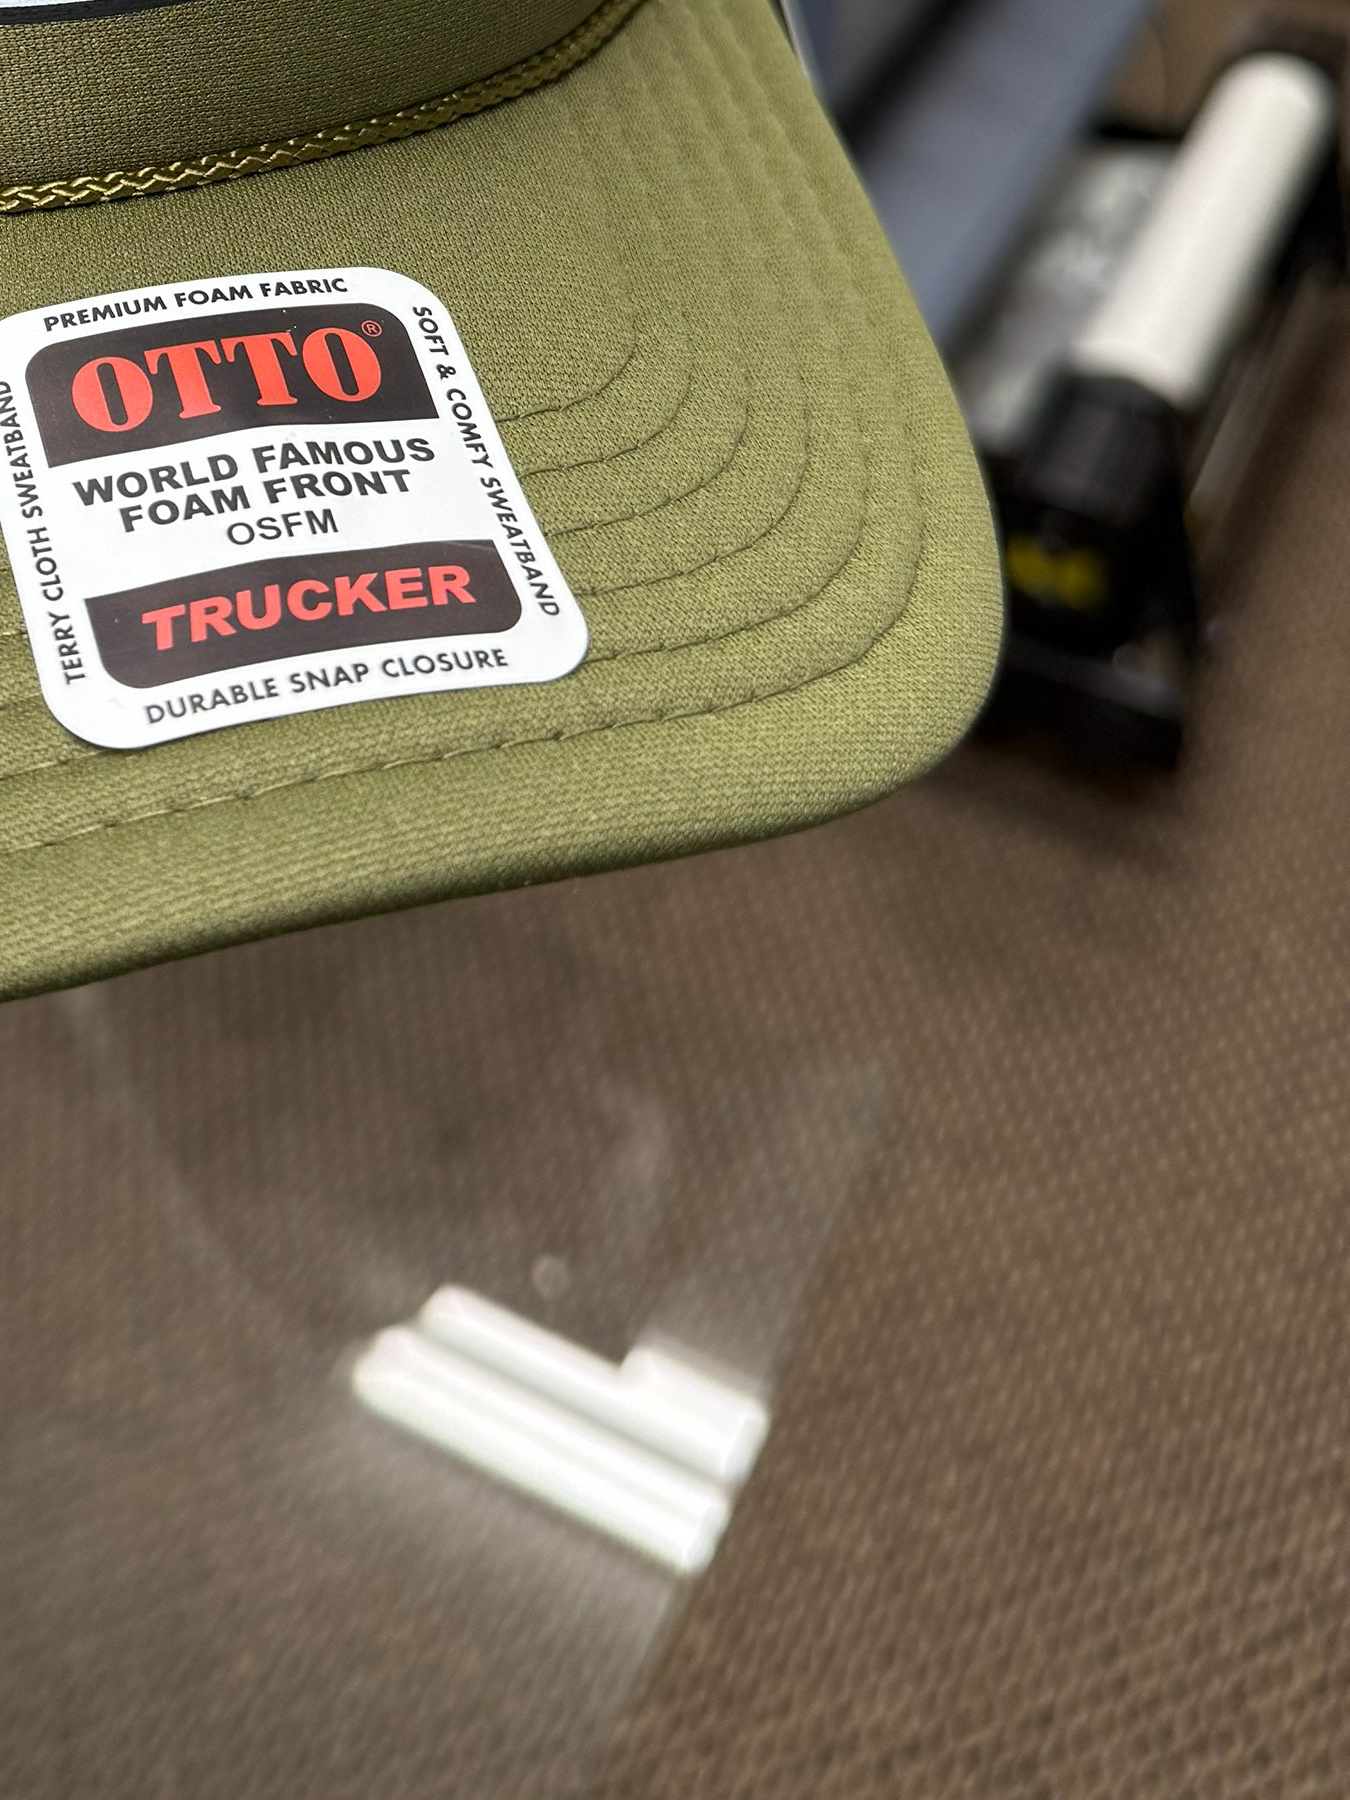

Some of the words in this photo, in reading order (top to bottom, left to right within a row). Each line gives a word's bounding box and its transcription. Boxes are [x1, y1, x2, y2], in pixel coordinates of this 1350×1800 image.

[43, 294, 168, 333] PREMIUM
[174, 283, 253, 309] FOAM
[259, 276, 349, 299] FABRIC
[411, 305, 450, 360] SOFT
[436, 363, 457, 381] &
[446, 387, 493, 469] COMFY
[72, 451, 238, 508] WORLD
[252, 437, 436, 474] FAMOUS
[118, 485, 252, 533] FOAM
[262, 469, 412, 505] FRONT
[27, 526, 64, 602] CLOTH
[226, 509, 340, 547] OSFM
[480, 476, 561, 618] SWEATBAND
[140, 564, 477, 651] TRUCKER
[46, 611, 86, 685] TERRY
[144, 681, 280, 725] DURABLE
[289, 662, 369, 695] SNAP
[382, 648, 509, 679] CLOSURE
